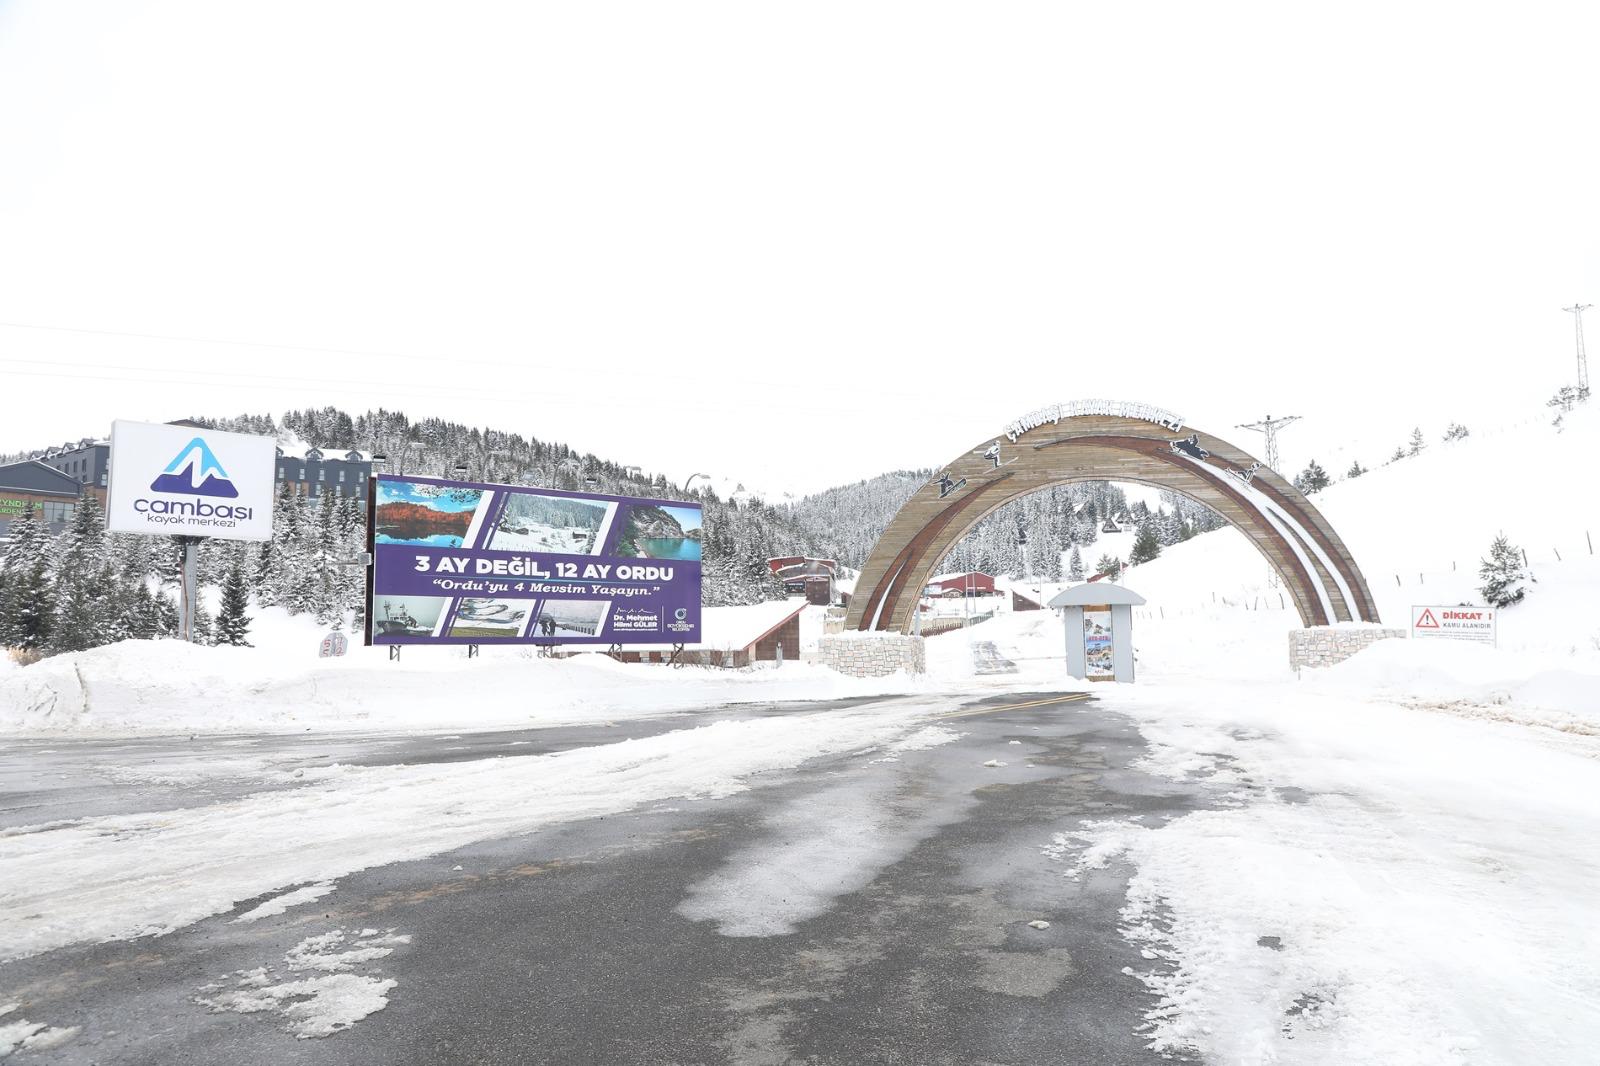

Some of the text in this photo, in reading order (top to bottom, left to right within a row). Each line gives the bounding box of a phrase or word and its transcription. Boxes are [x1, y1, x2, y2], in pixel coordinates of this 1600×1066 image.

[1070, 399, 1112, 416] KAYAK
[134, 498, 253, 521] çambaşı
[147, 513, 236, 528] kayak merkezi
[414, 555, 674, 580] 3 AY DEĞİL, 12 AY ORDU
[514, 583, 525, 592] 4
[529, 583, 587, 594] Mevsim
[1443, 611, 1483, 620] DİKKAT
[633, 620, 658, 628] GÜLER
